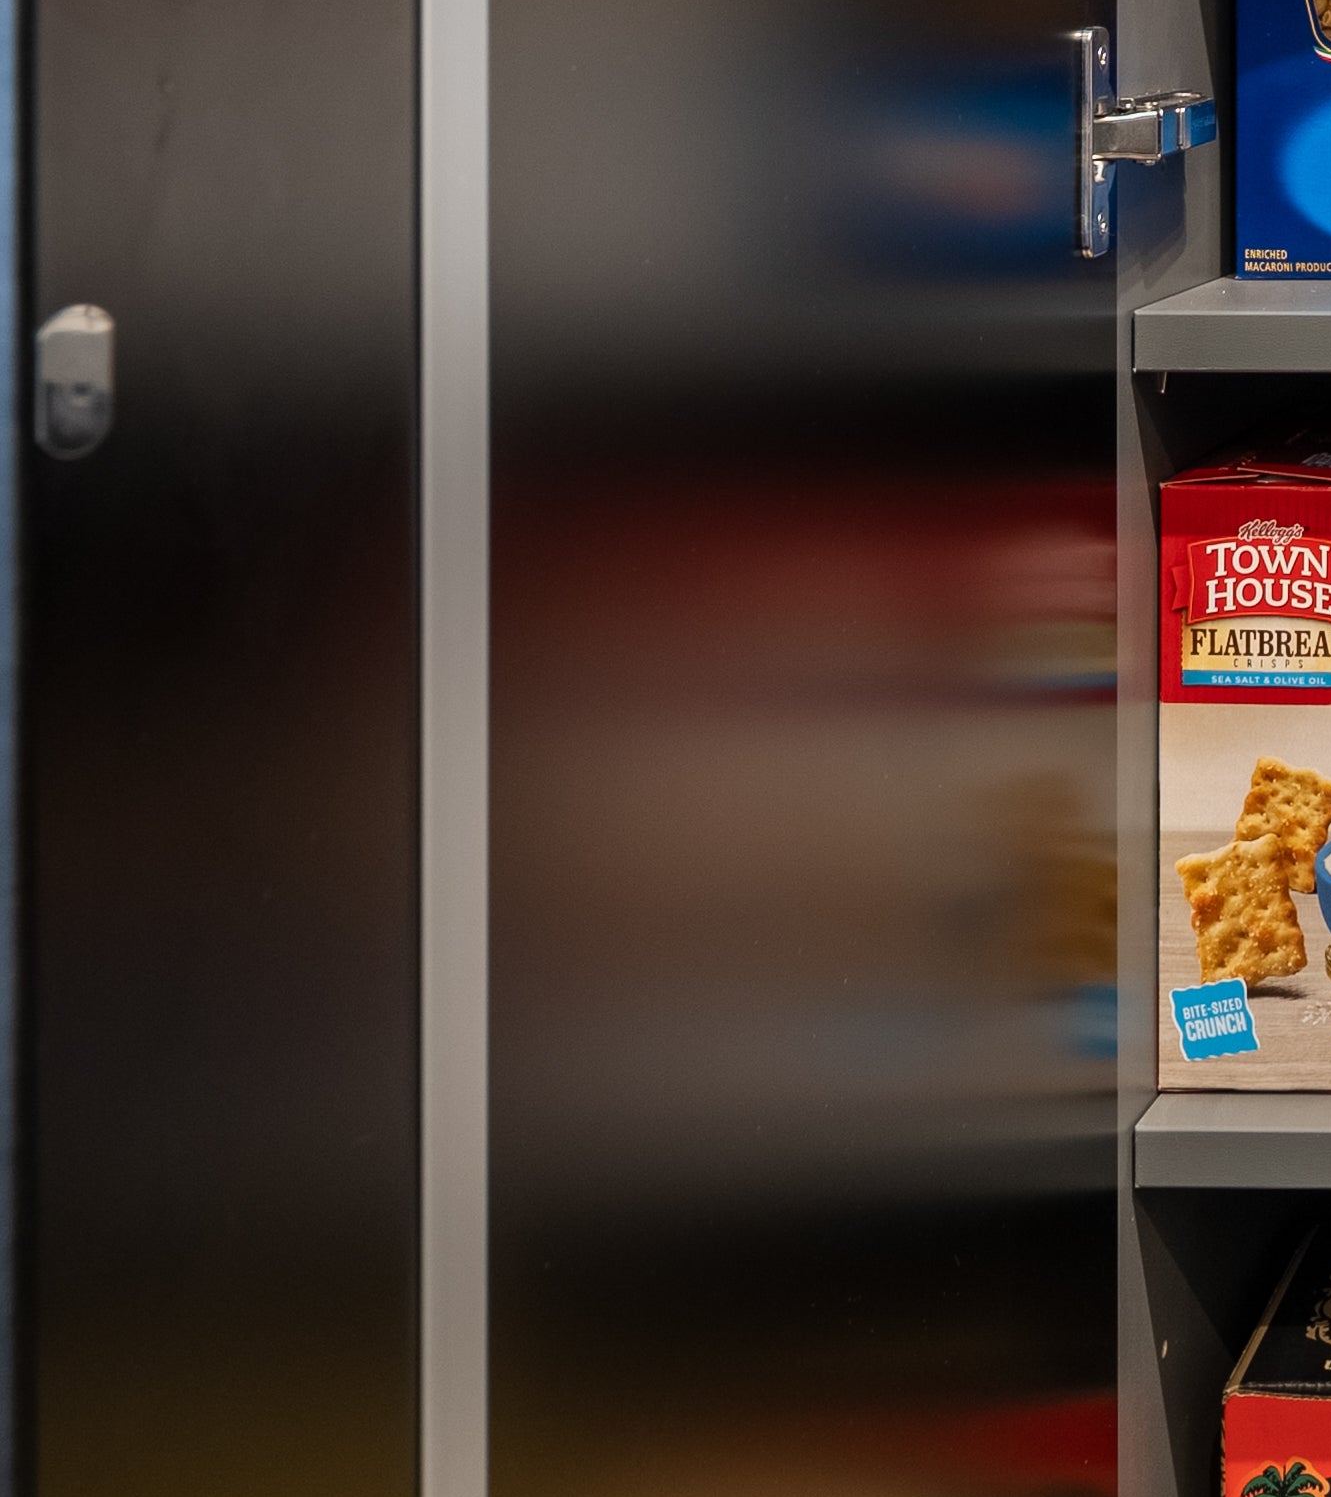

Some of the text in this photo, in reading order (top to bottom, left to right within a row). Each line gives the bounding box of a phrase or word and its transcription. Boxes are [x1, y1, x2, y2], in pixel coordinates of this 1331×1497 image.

[1238, 519, 1303, 544] Kellogg's
[1206, 543, 1330, 579] TOWN
[1182, 1001, 1244, 1020] BITE-SIZED
[1185, 1014, 1247, 1039] CRUNCH
